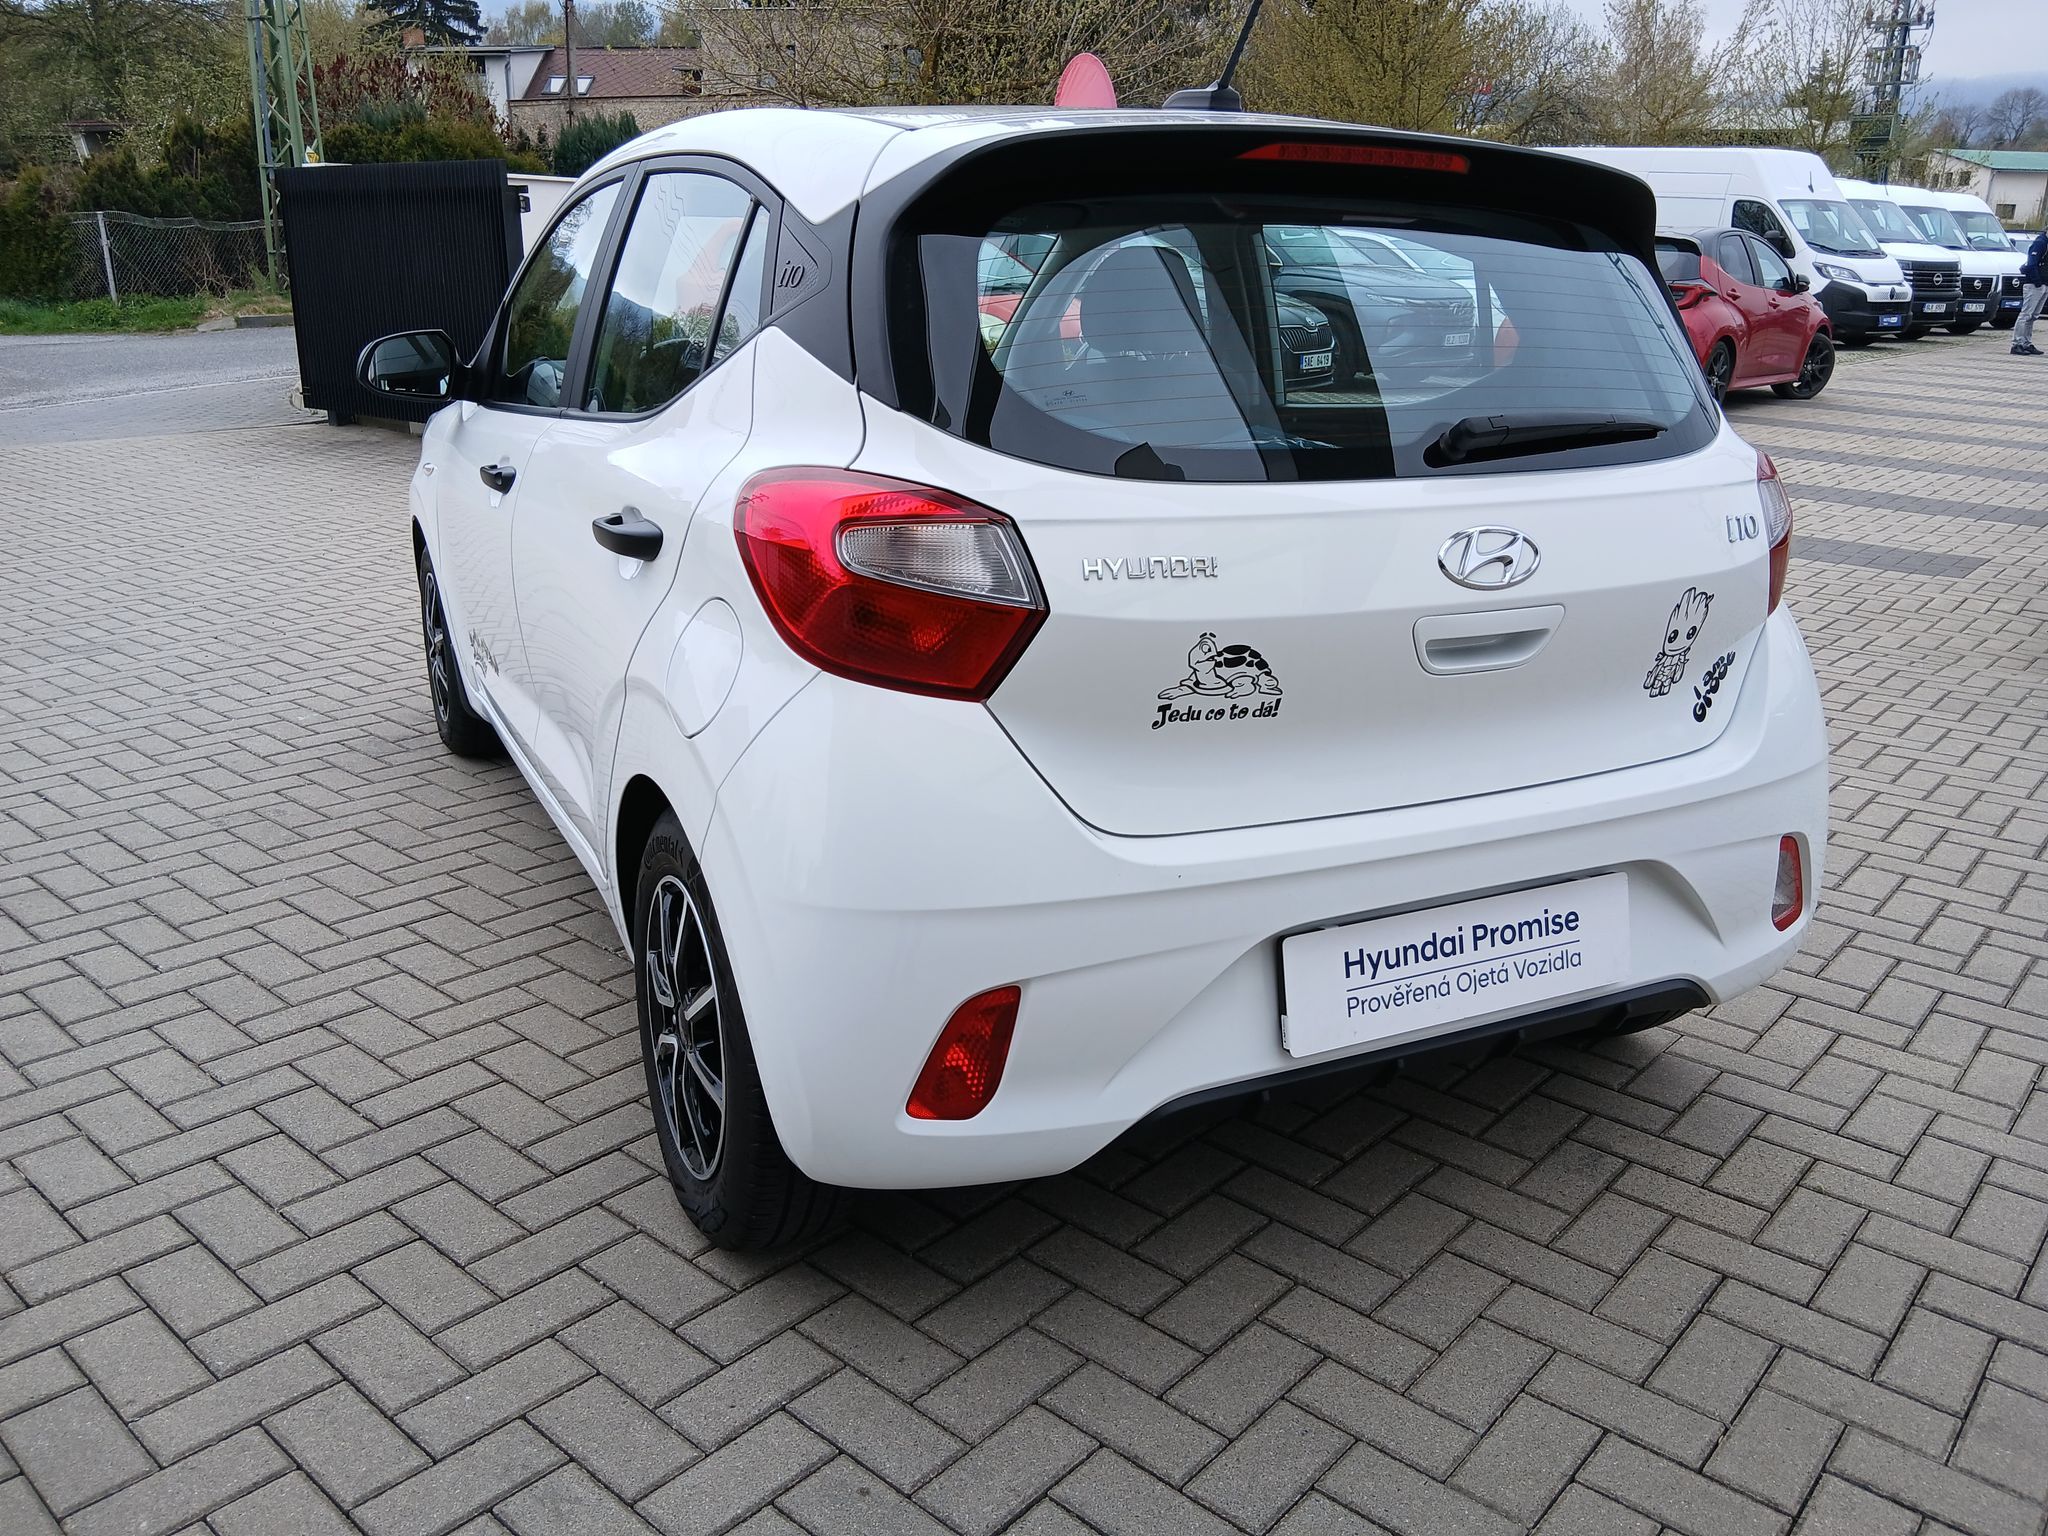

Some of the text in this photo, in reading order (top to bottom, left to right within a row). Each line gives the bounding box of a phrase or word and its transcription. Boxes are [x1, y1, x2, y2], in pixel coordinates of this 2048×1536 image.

[777, 260, 805, 288] i10
[1082, 555, 1218, 580] HYUNDAI
[1702, 656, 1725, 687] am
[1151, 698, 1282, 729] Jedu co to dá!
[1343, 908, 1580, 980] Hyundai Promise
[1346, 949, 1582, 1018] Prověřená Ojetá Vozidla
